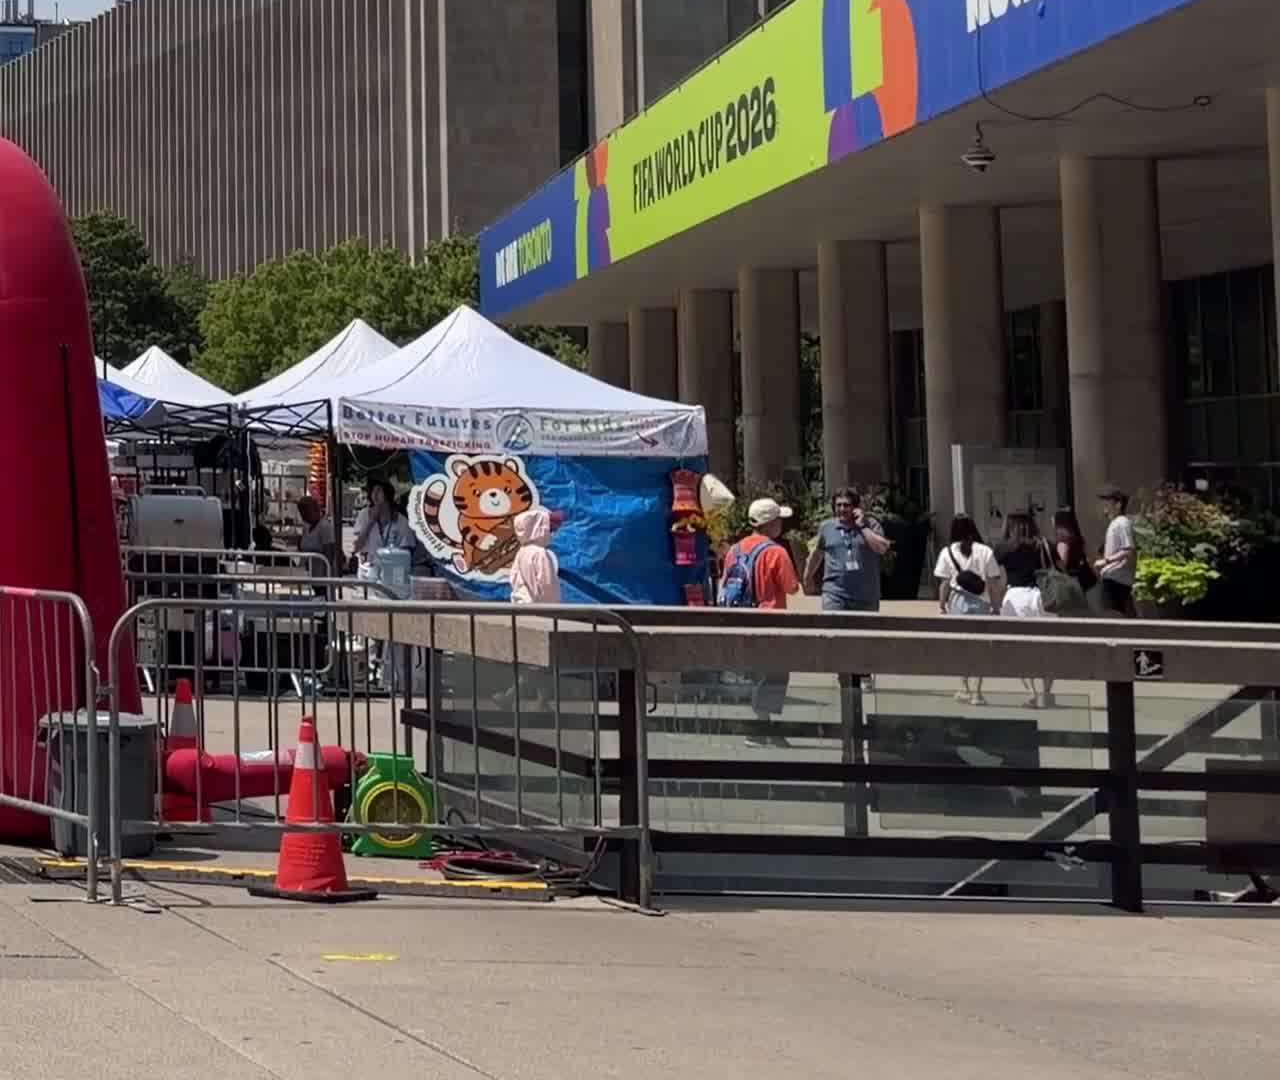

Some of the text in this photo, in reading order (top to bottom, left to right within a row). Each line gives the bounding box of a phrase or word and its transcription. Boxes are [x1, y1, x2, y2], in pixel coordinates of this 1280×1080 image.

[633, 76, 777, 215] FIFA WORLD CUP 2026
[343, 405, 493, 430] Better Futures
[540, 416, 570, 432] For
[343, 431, 372, 440] STOP
[374, 434, 416, 445] HUMAN
